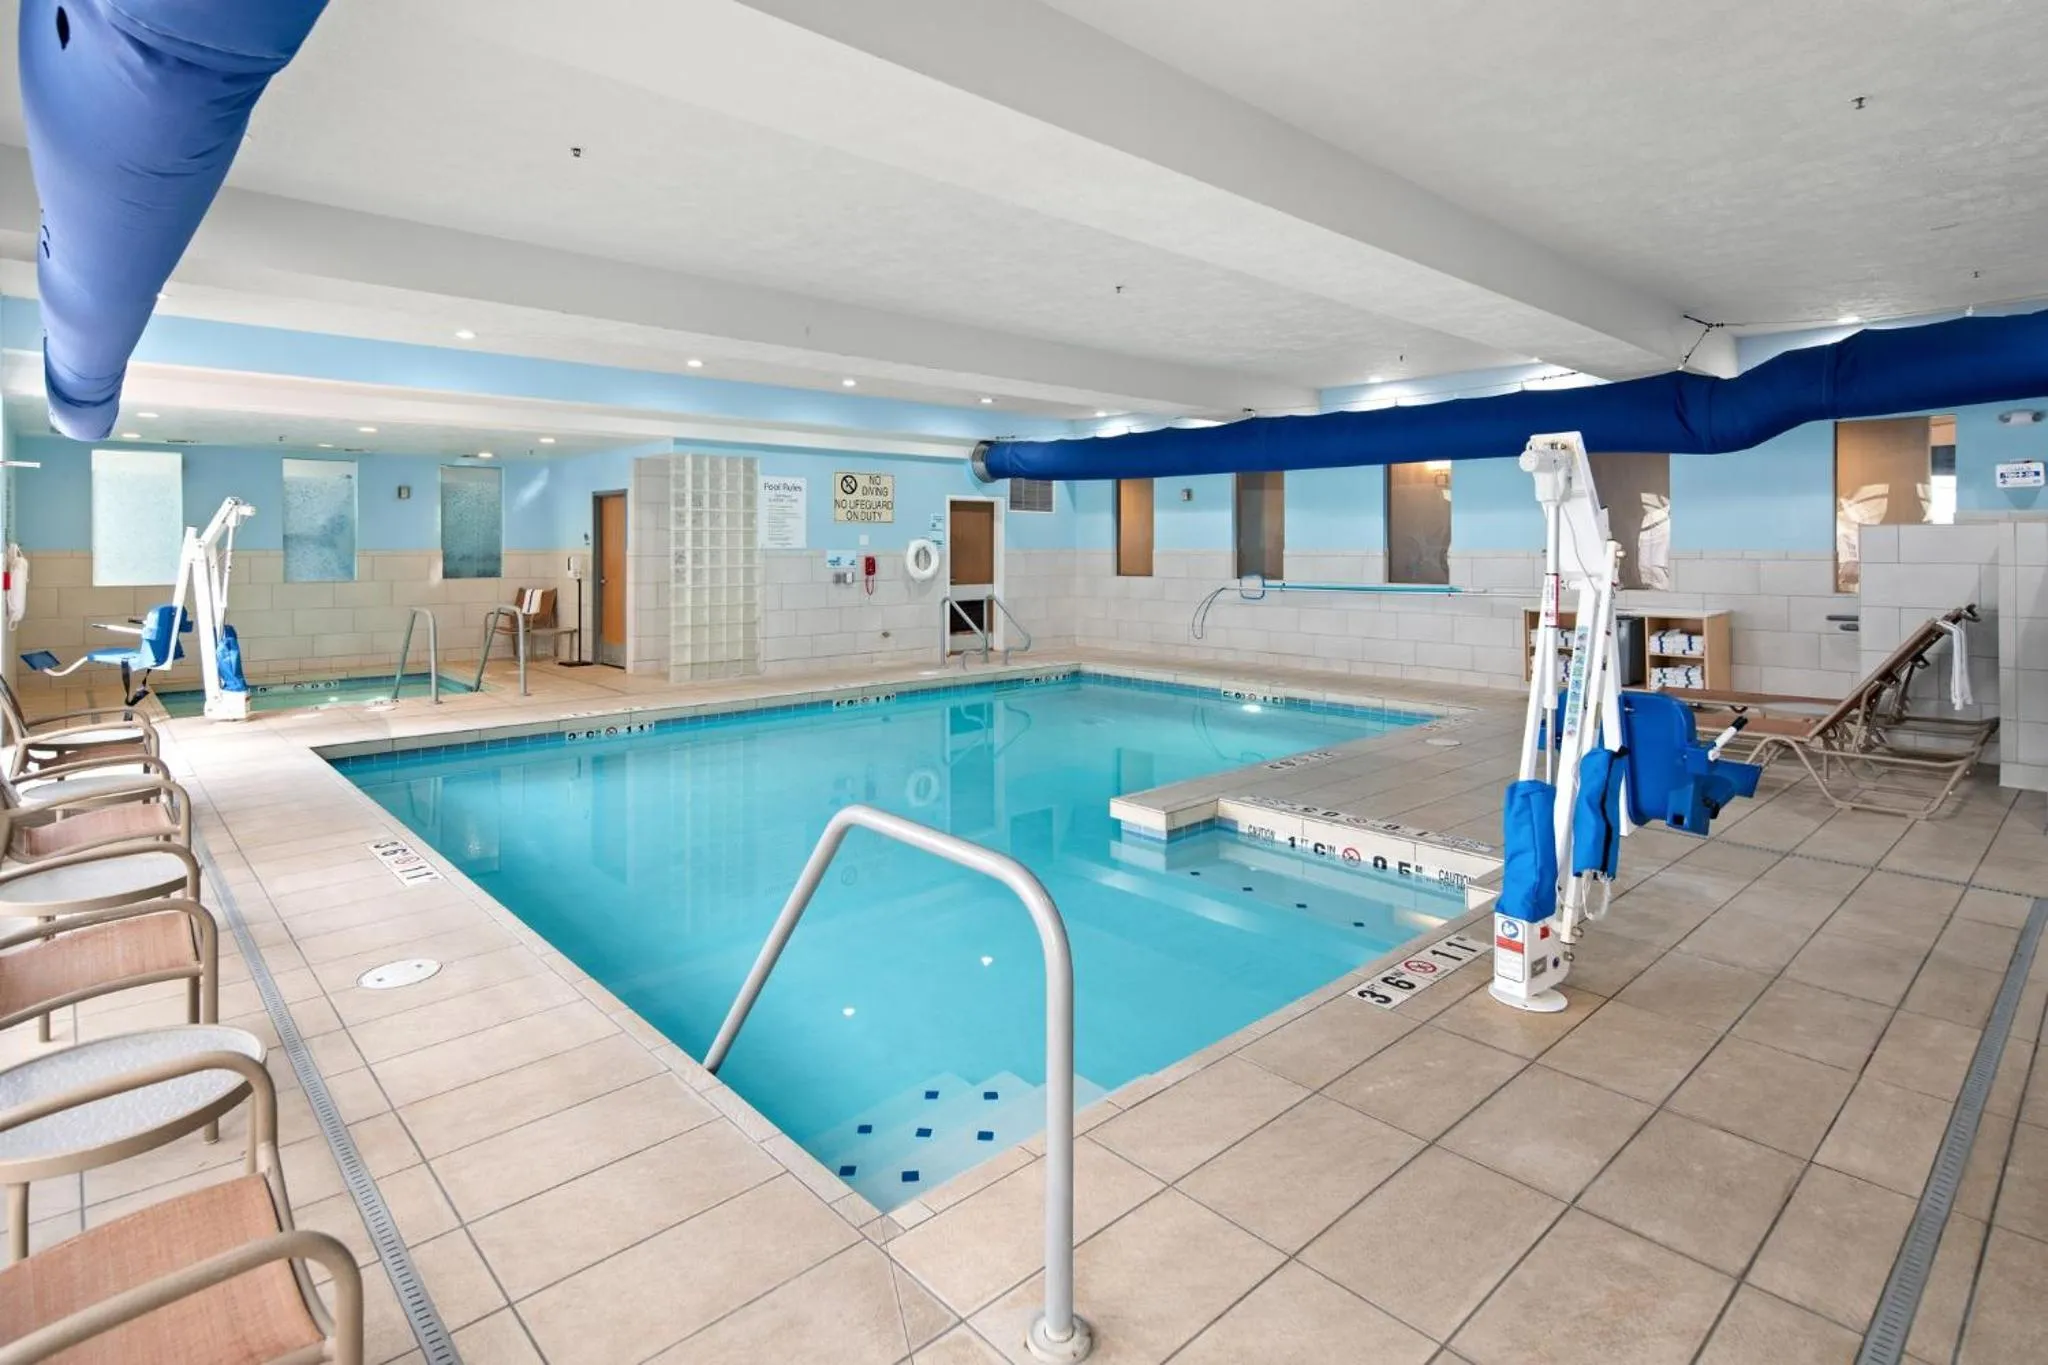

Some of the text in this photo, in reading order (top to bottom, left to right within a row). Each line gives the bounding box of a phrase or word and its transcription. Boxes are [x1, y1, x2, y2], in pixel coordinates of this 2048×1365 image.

[869, 475, 881, 486] NO
[763, 482, 802, 492] Pool Rules
[861, 486, 888, 497] DIVING
[834, 499, 893, 510] NO LIFEGUARD
[846, 510, 882, 521] ON DUTY
[1438, 869, 1473, 888] CAUTION
[1357, 989, 1392, 1005] 3
[1381, 975, 1416, 990] 6
